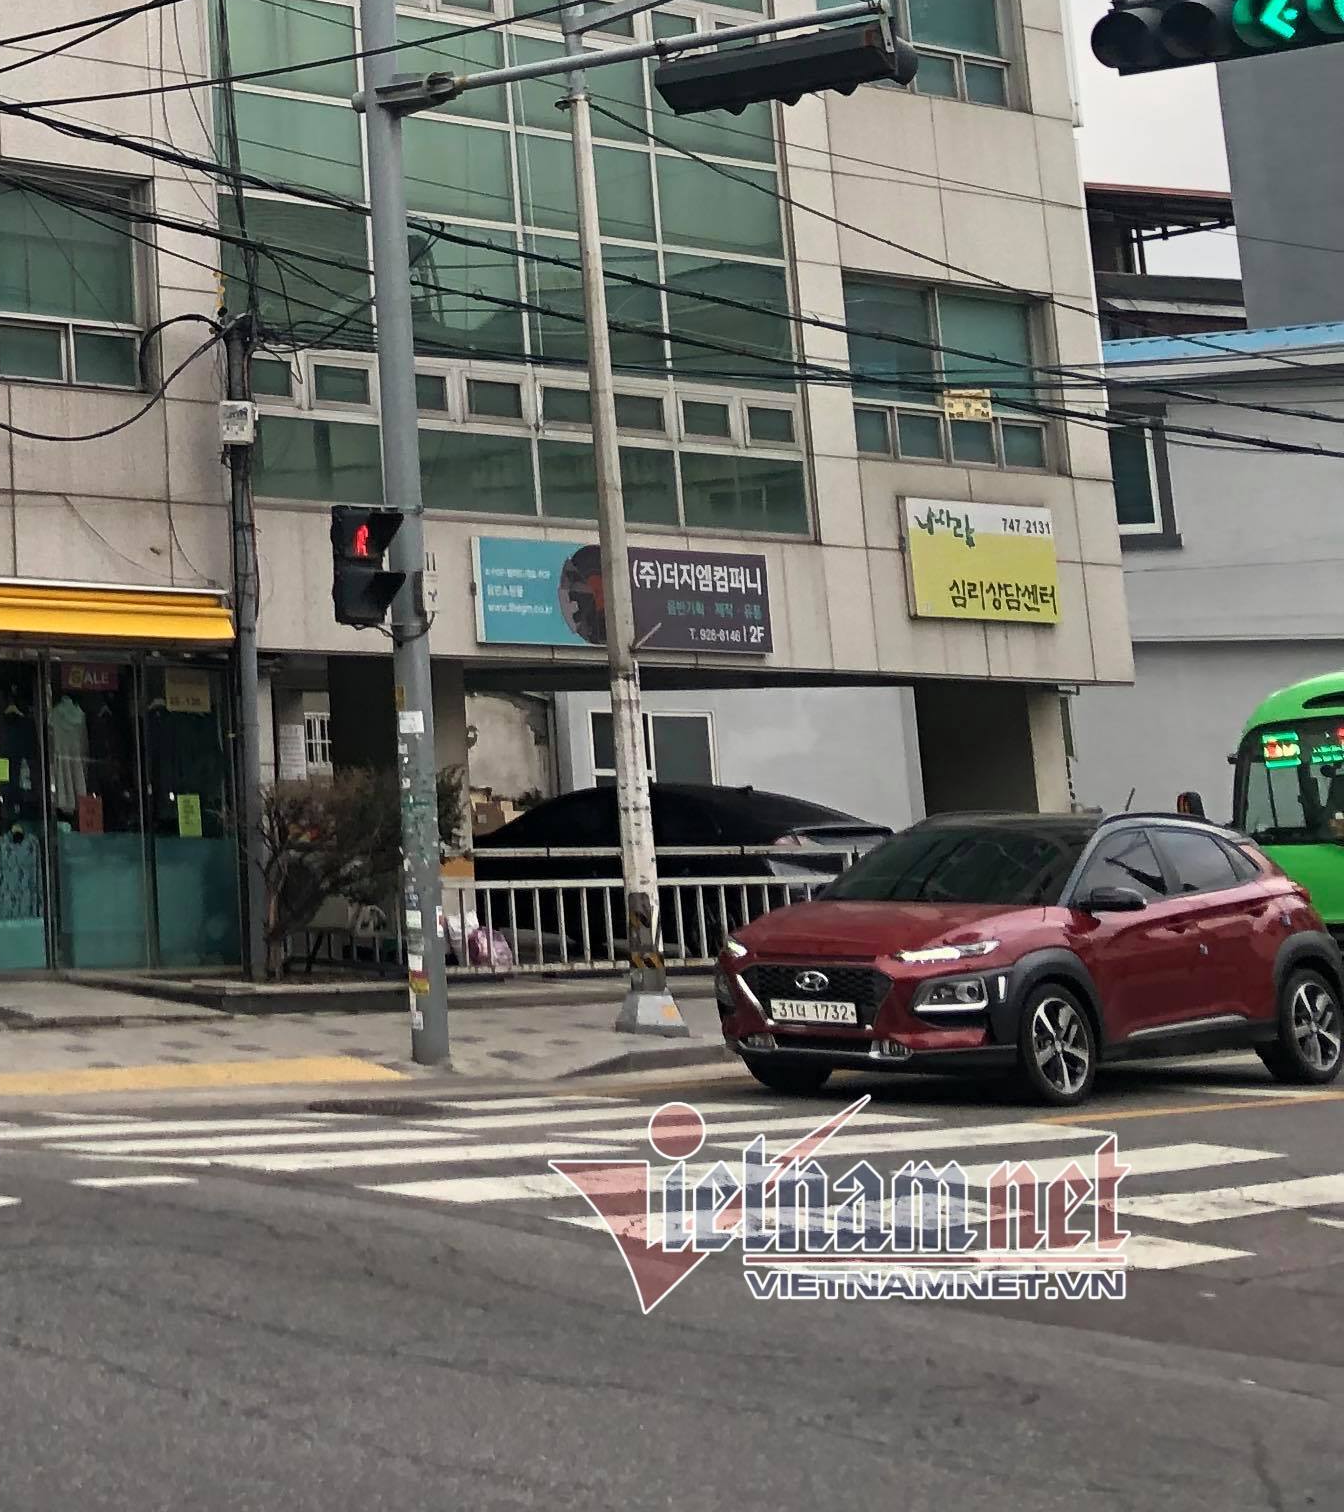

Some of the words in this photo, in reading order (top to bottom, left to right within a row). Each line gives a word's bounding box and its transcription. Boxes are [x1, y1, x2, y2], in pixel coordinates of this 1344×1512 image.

[632, 559, 763, 596] (주)더지엠컴퍼니
[949, 579, 1058, 615] 심리상담센터
[750, 625, 765, 643] 2F
[814, 1002, 849, 1021] 1732
